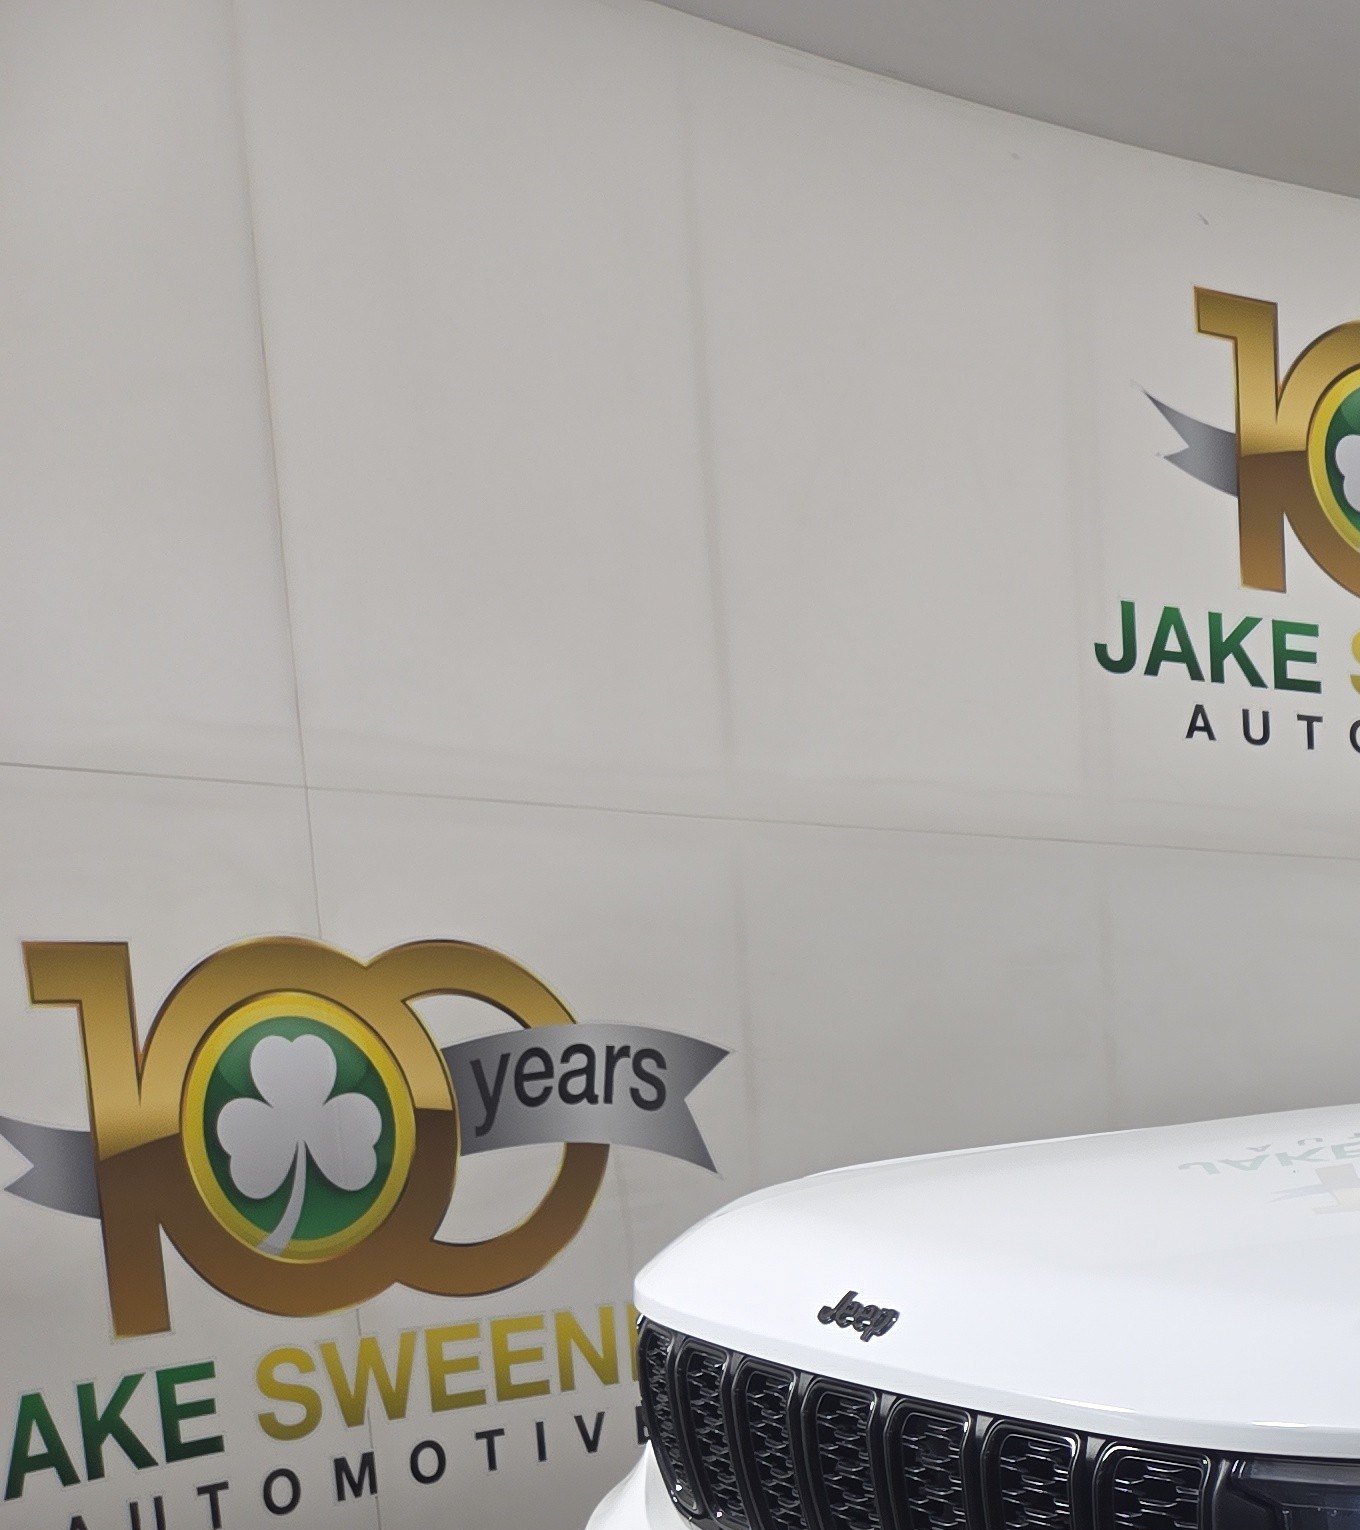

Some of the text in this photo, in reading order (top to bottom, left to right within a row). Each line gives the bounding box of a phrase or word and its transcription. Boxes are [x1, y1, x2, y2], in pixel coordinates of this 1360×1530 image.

[1093, 600, 1323, 695] JAKE
[22, 936, 669, 1340] 100 years
[817, 1290, 900, 1342] Jeep
[4, 1302, 640, 1501] AKE SWEEN
